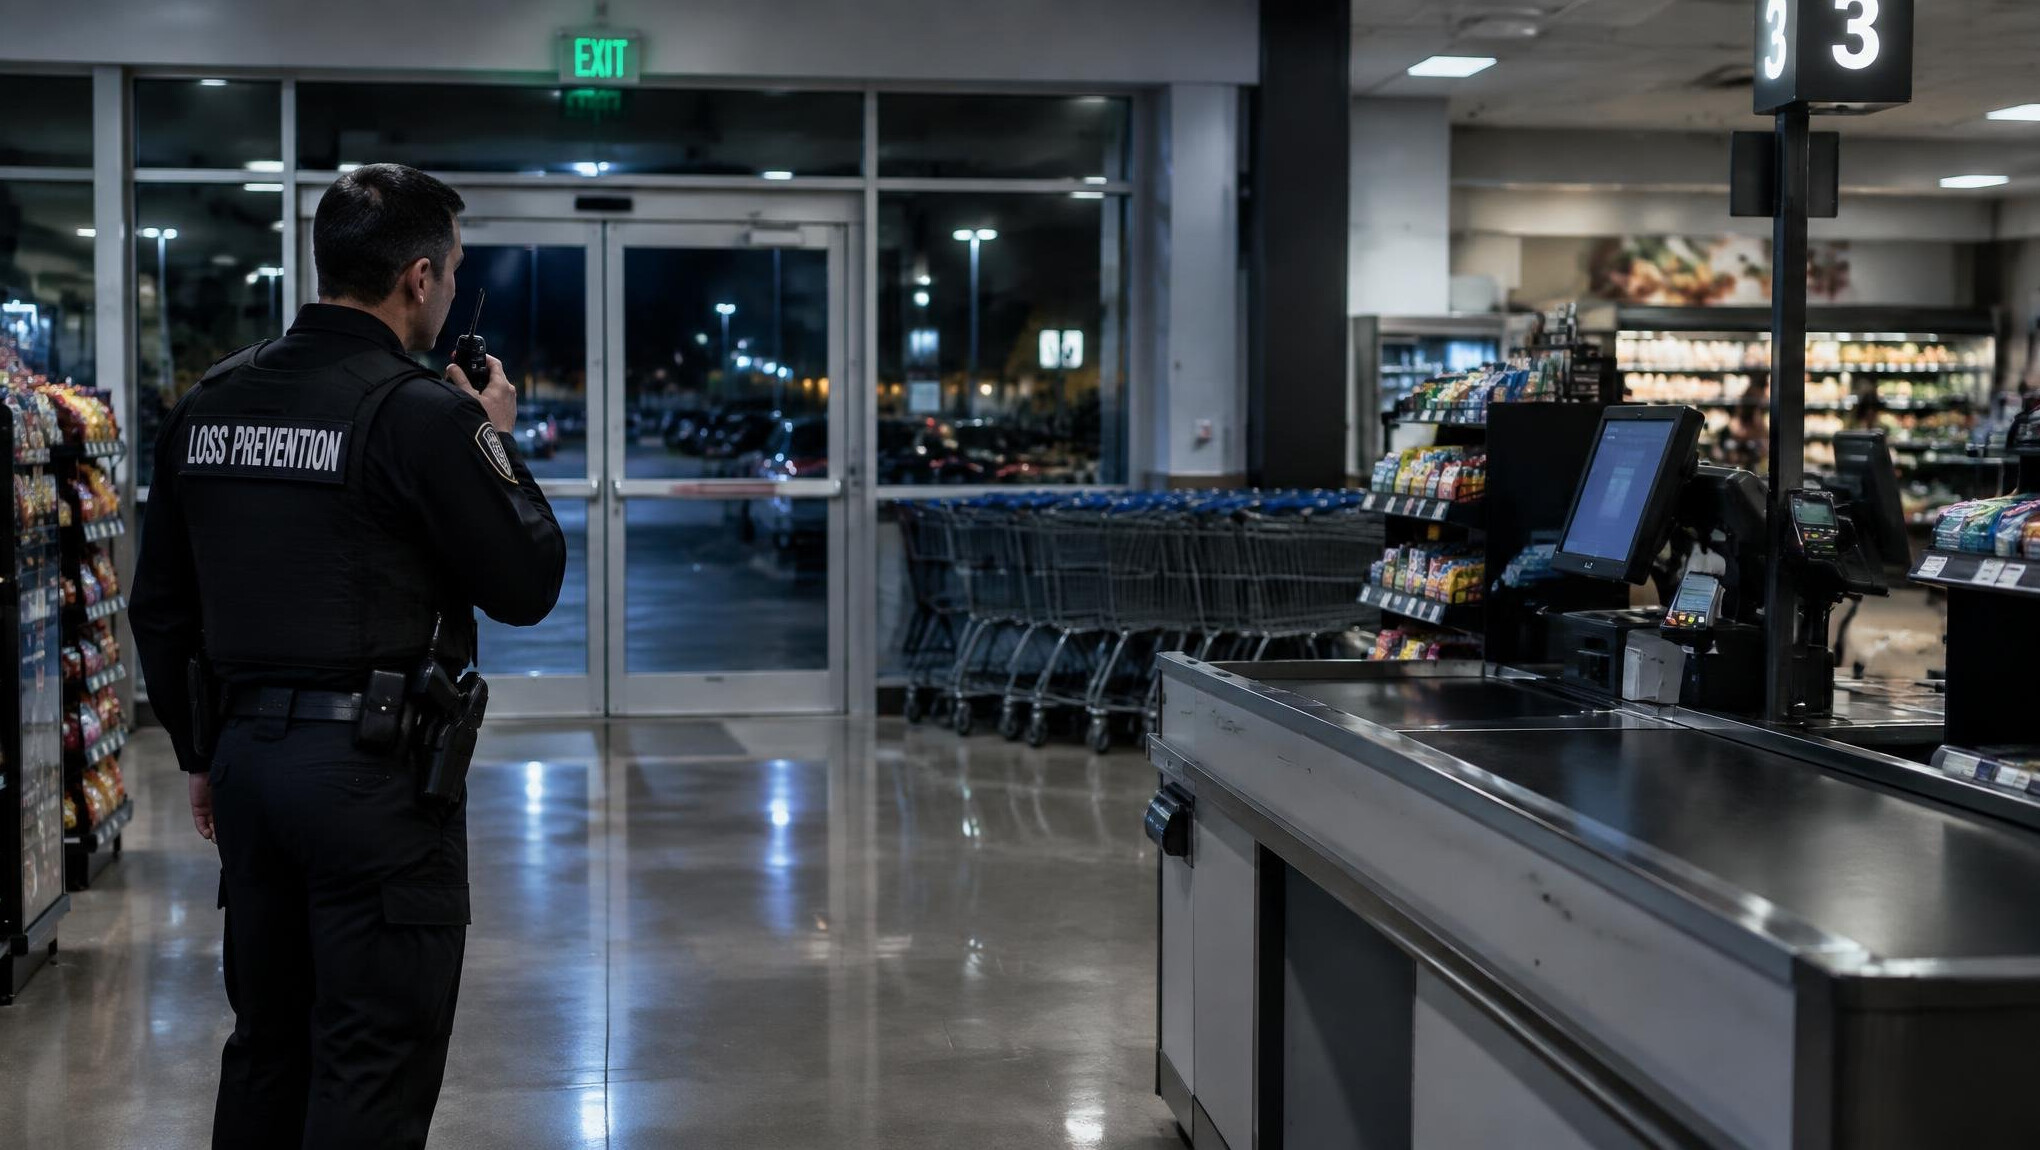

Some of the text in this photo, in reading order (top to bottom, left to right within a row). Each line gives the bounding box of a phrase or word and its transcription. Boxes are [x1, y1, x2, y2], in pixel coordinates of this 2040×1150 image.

[574, 37, 628, 78] EXIT
[1764, 0, 1787, 80] 3
[1832, 0, 1880, 70] 3
[187, 424, 343, 472] LOSS PREVENTION
